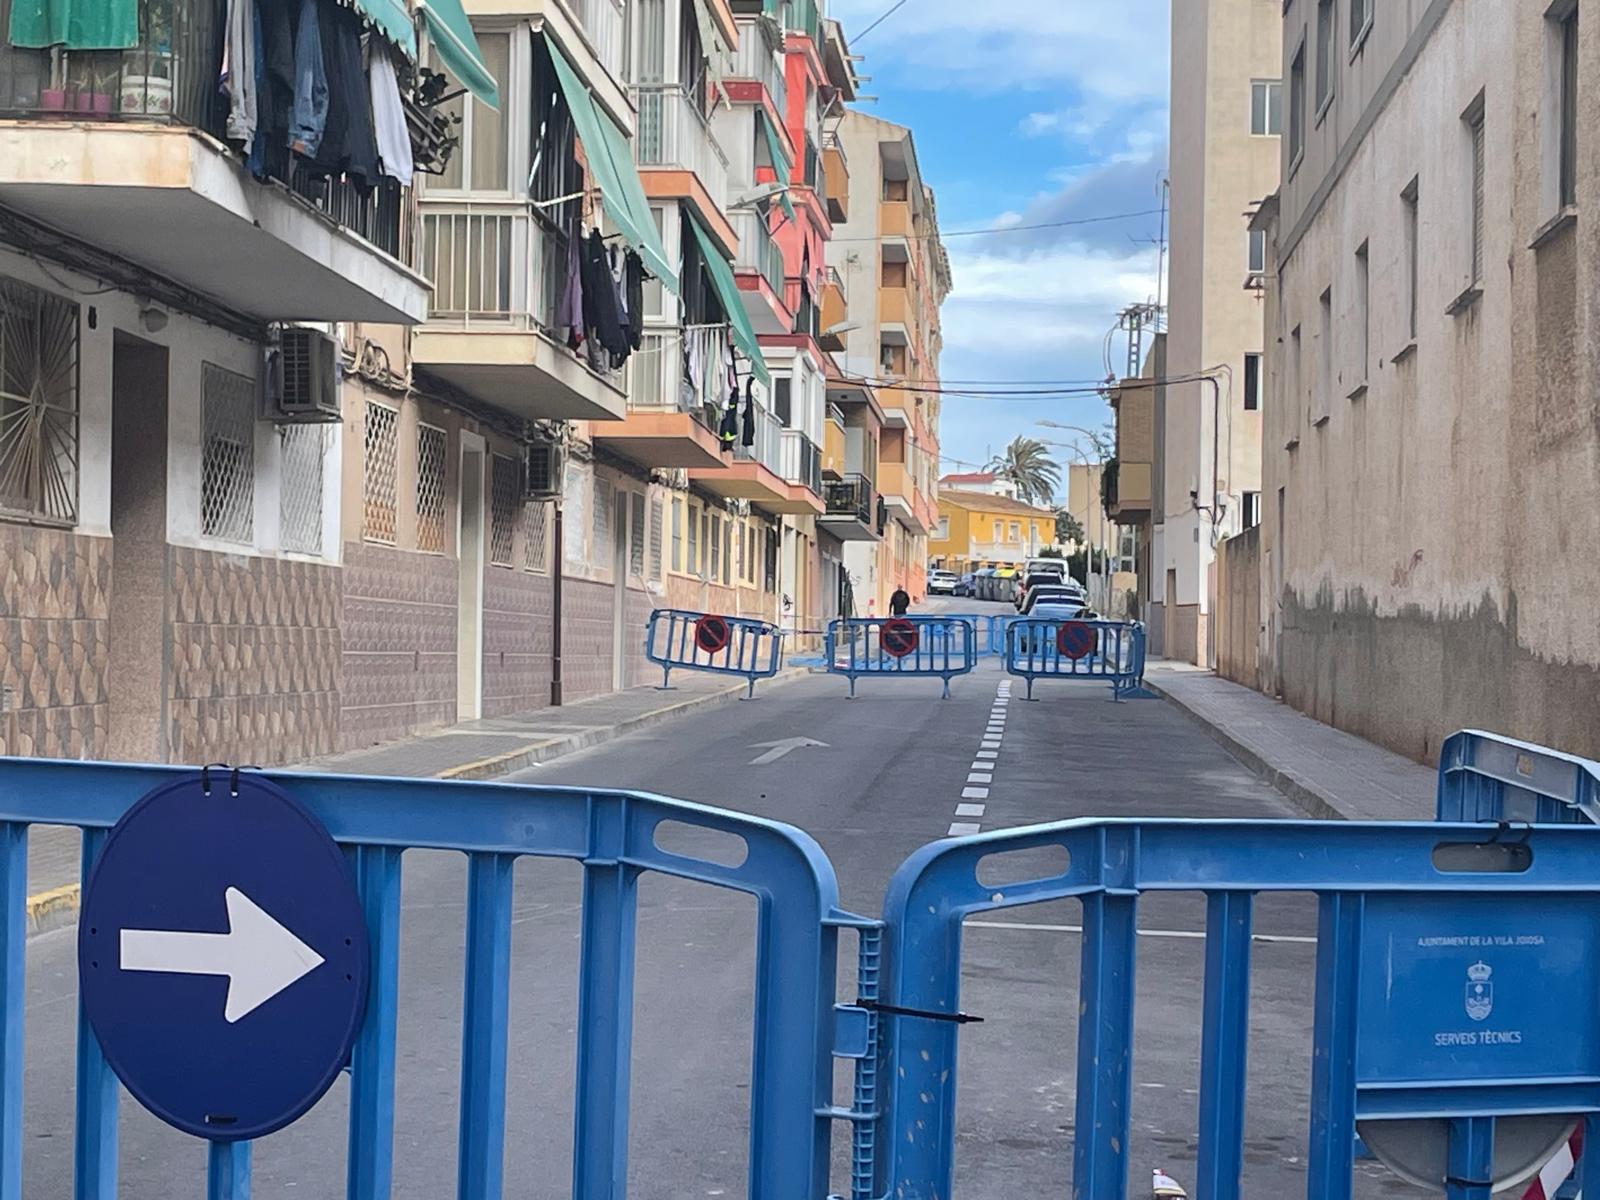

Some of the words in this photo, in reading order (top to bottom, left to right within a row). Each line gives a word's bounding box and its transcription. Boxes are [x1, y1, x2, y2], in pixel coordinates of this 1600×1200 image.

[1417, 935, 1469, 947] AJUNTAMENT
[1469, 935, 1480, 946] DE
[1482, 935, 1493, 946] LA
[1494, 935, 1513, 945] VILA
[1434, 1032, 1477, 1046] SERVEIS
